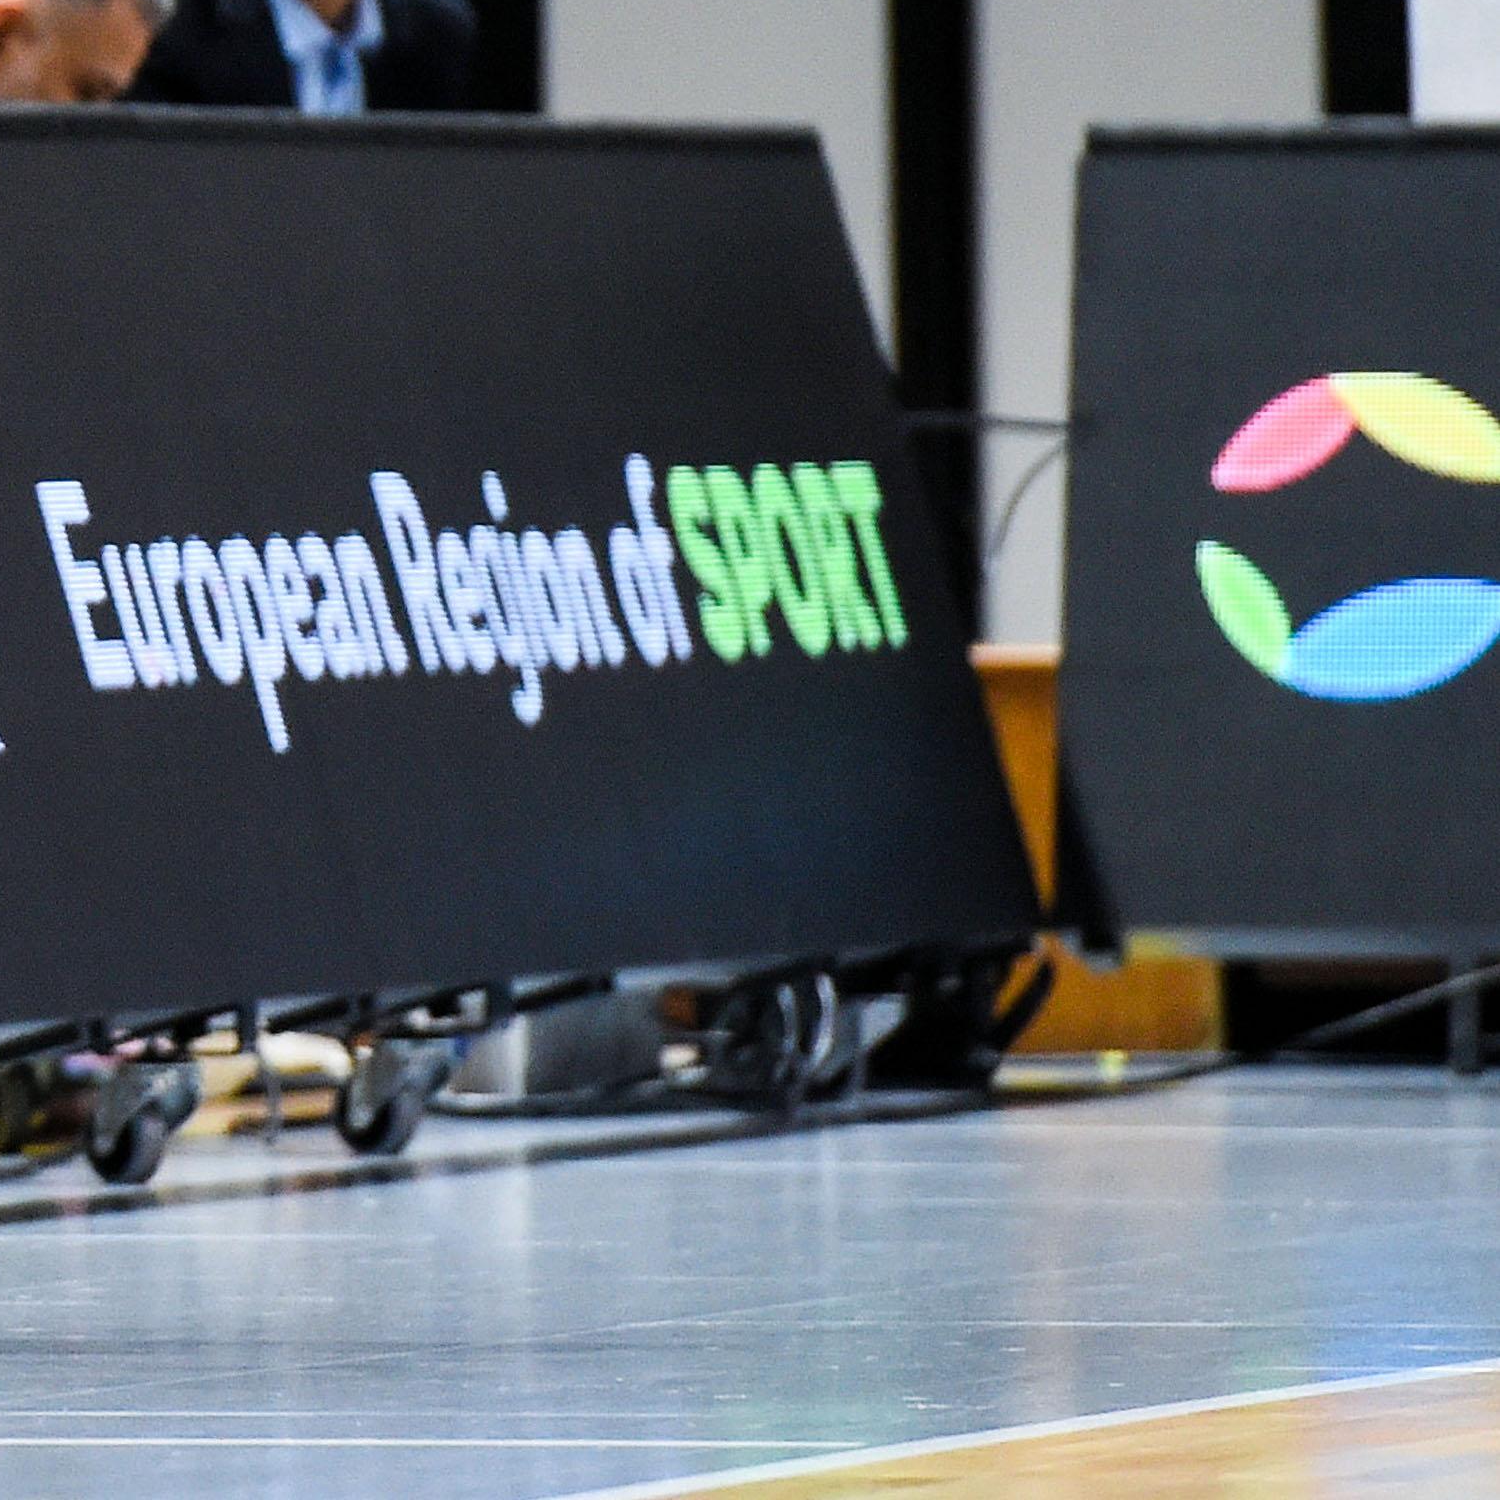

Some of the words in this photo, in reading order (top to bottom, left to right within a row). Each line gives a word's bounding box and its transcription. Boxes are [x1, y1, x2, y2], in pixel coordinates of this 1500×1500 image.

[34, 478, 411, 754] European
[369, 469, 628, 726] Region
[607, 451, 693, 669] of
[666, 459, 909, 663] SPORT
